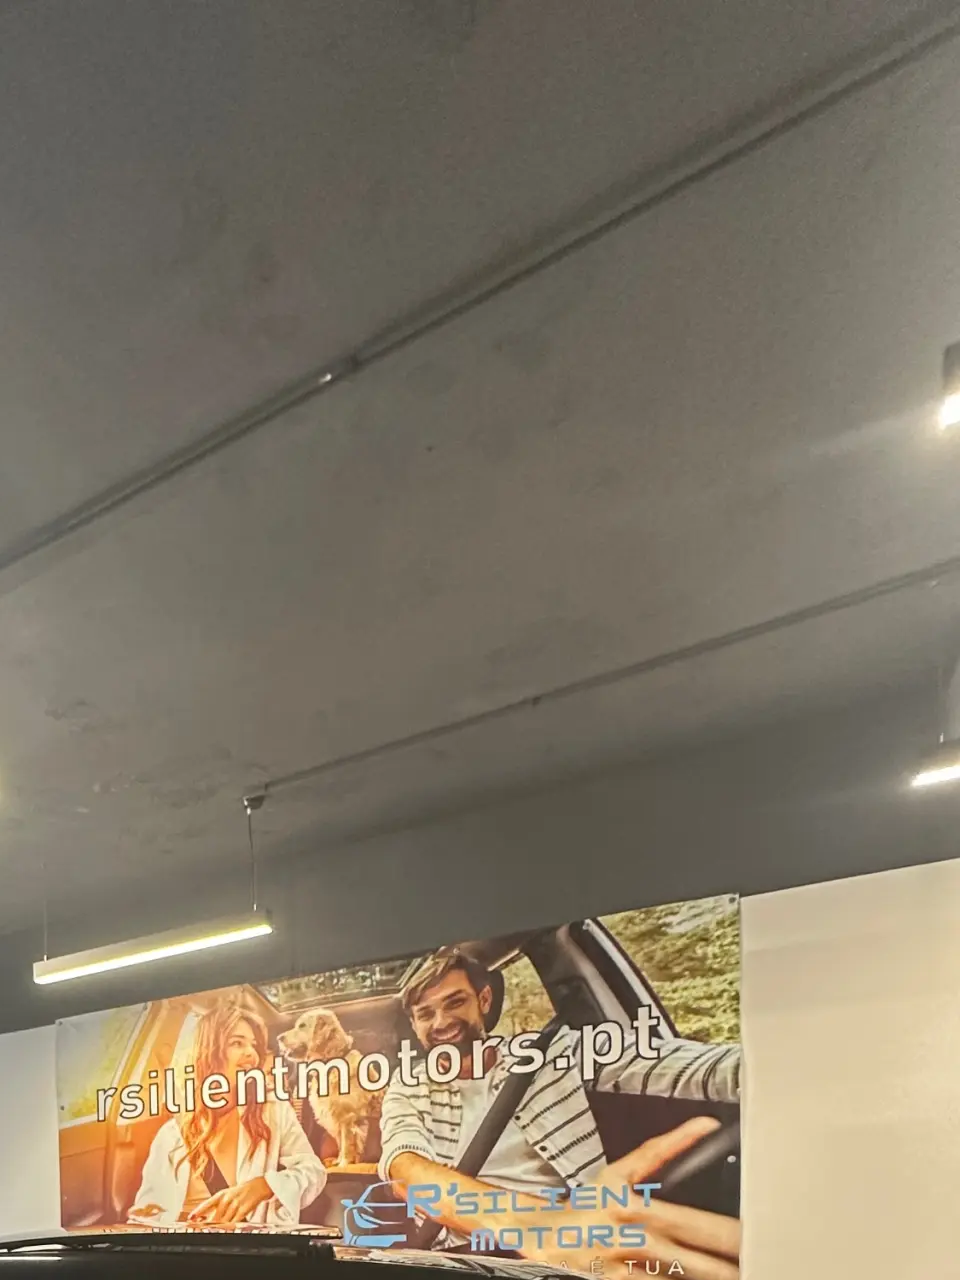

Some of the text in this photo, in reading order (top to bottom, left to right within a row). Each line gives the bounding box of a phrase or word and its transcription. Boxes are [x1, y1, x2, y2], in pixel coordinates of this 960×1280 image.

[96, 1004, 662, 1122] rsilientmotors.pt
[406, 1182, 662, 1218] R'SILIENT
[470, 1223, 647, 1251] MOTORS
[591, 1256, 605, 1276] É
[624, 1259, 685, 1276] TUA
